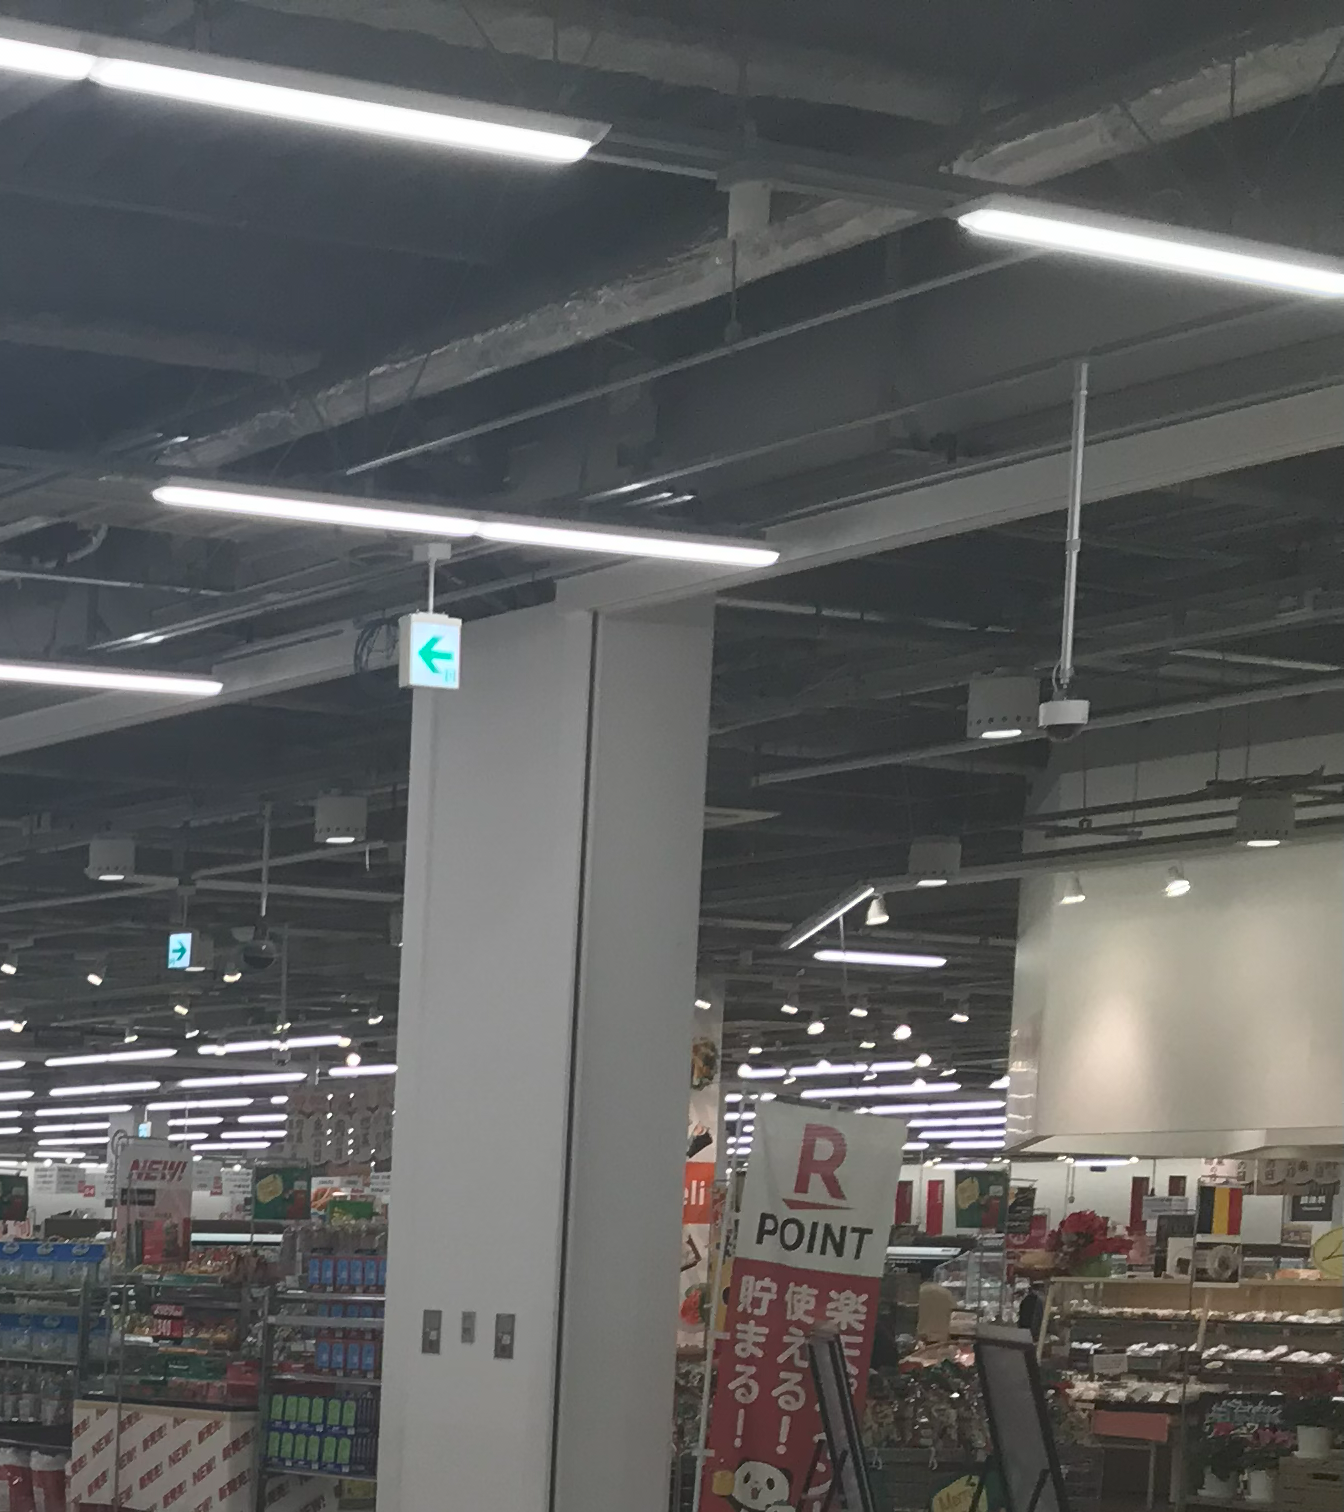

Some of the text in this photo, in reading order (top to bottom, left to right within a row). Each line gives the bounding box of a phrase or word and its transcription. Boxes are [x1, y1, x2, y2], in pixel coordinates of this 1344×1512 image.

[130, 1159, 189, 1183] NEW!
[793, 1122, 848, 1200] R
[755, 1212, 874, 1261] POINT
[728, 1275, 778, 1448] 貯まる!
[771, 1282, 819, 1455] 使える!
